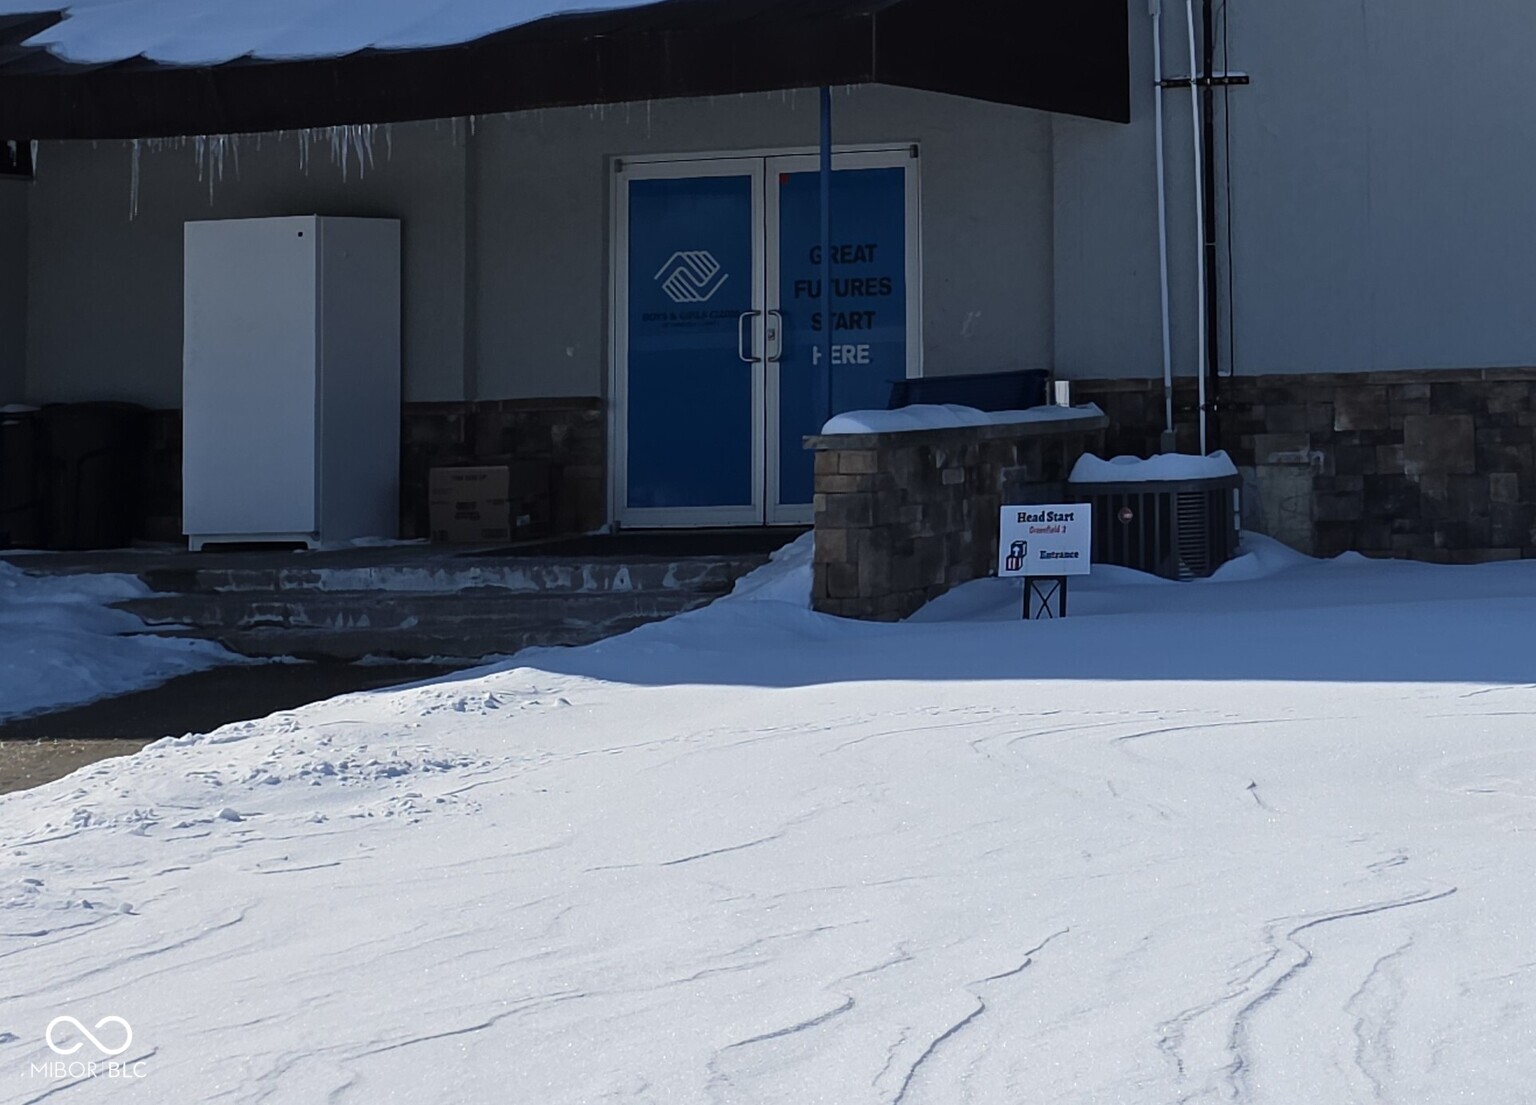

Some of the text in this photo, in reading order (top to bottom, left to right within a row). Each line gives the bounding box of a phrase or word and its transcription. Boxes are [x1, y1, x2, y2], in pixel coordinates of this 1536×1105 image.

[809, 243, 878, 265] GREAT
[794, 276, 893, 299] FUURES
[811, 310, 876, 331] SART
[1017, 511, 1074, 523] Head Start
[1040, 551, 1079, 559] Entrance
